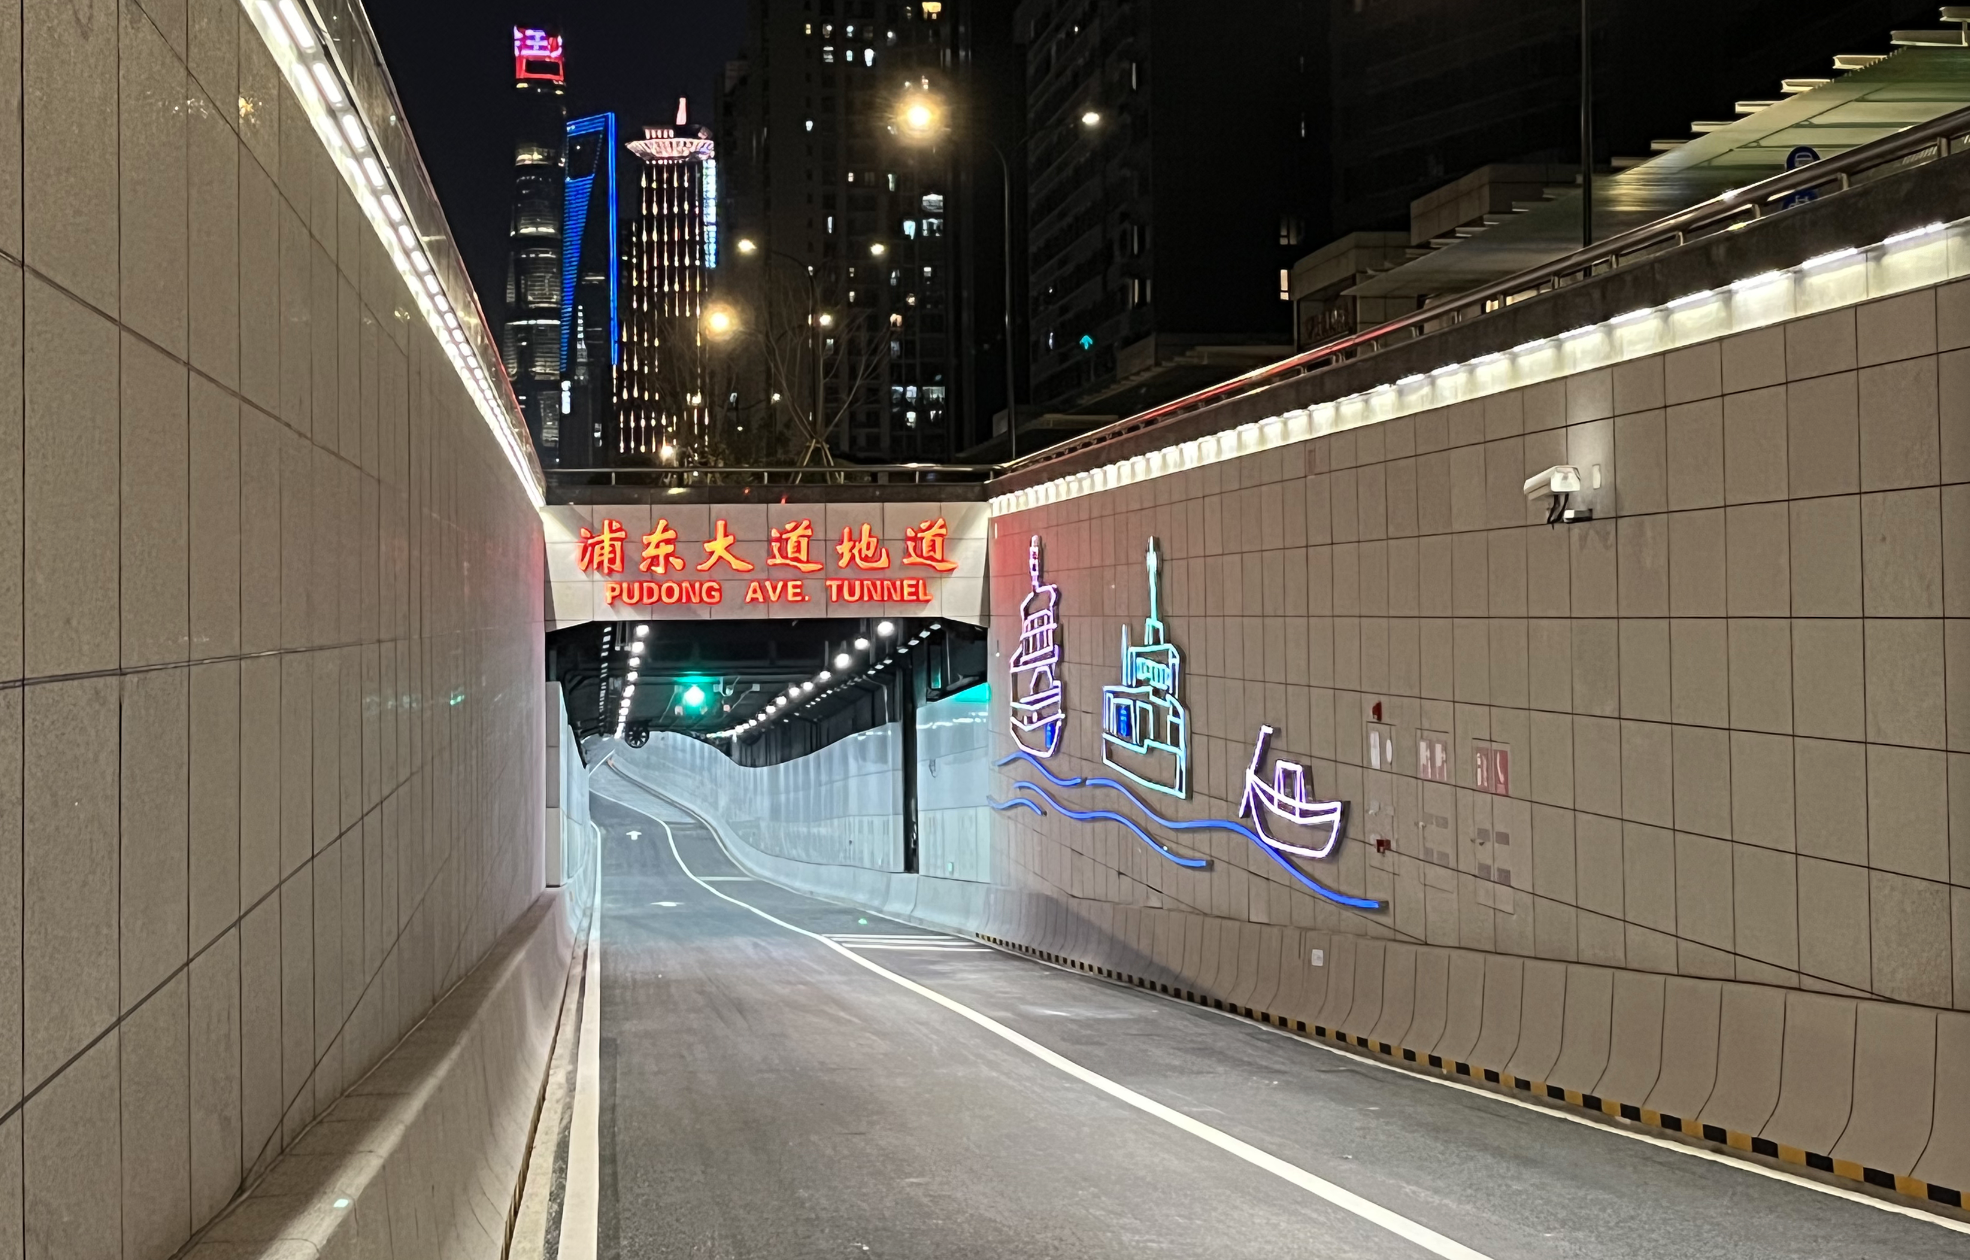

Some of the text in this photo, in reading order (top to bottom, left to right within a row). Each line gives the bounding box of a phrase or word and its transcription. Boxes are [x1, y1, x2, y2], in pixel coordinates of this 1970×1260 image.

[577, 517, 958, 575] 浦东大道地道
[605, 577, 934, 605] PUDONG AVE. TUNNEL
